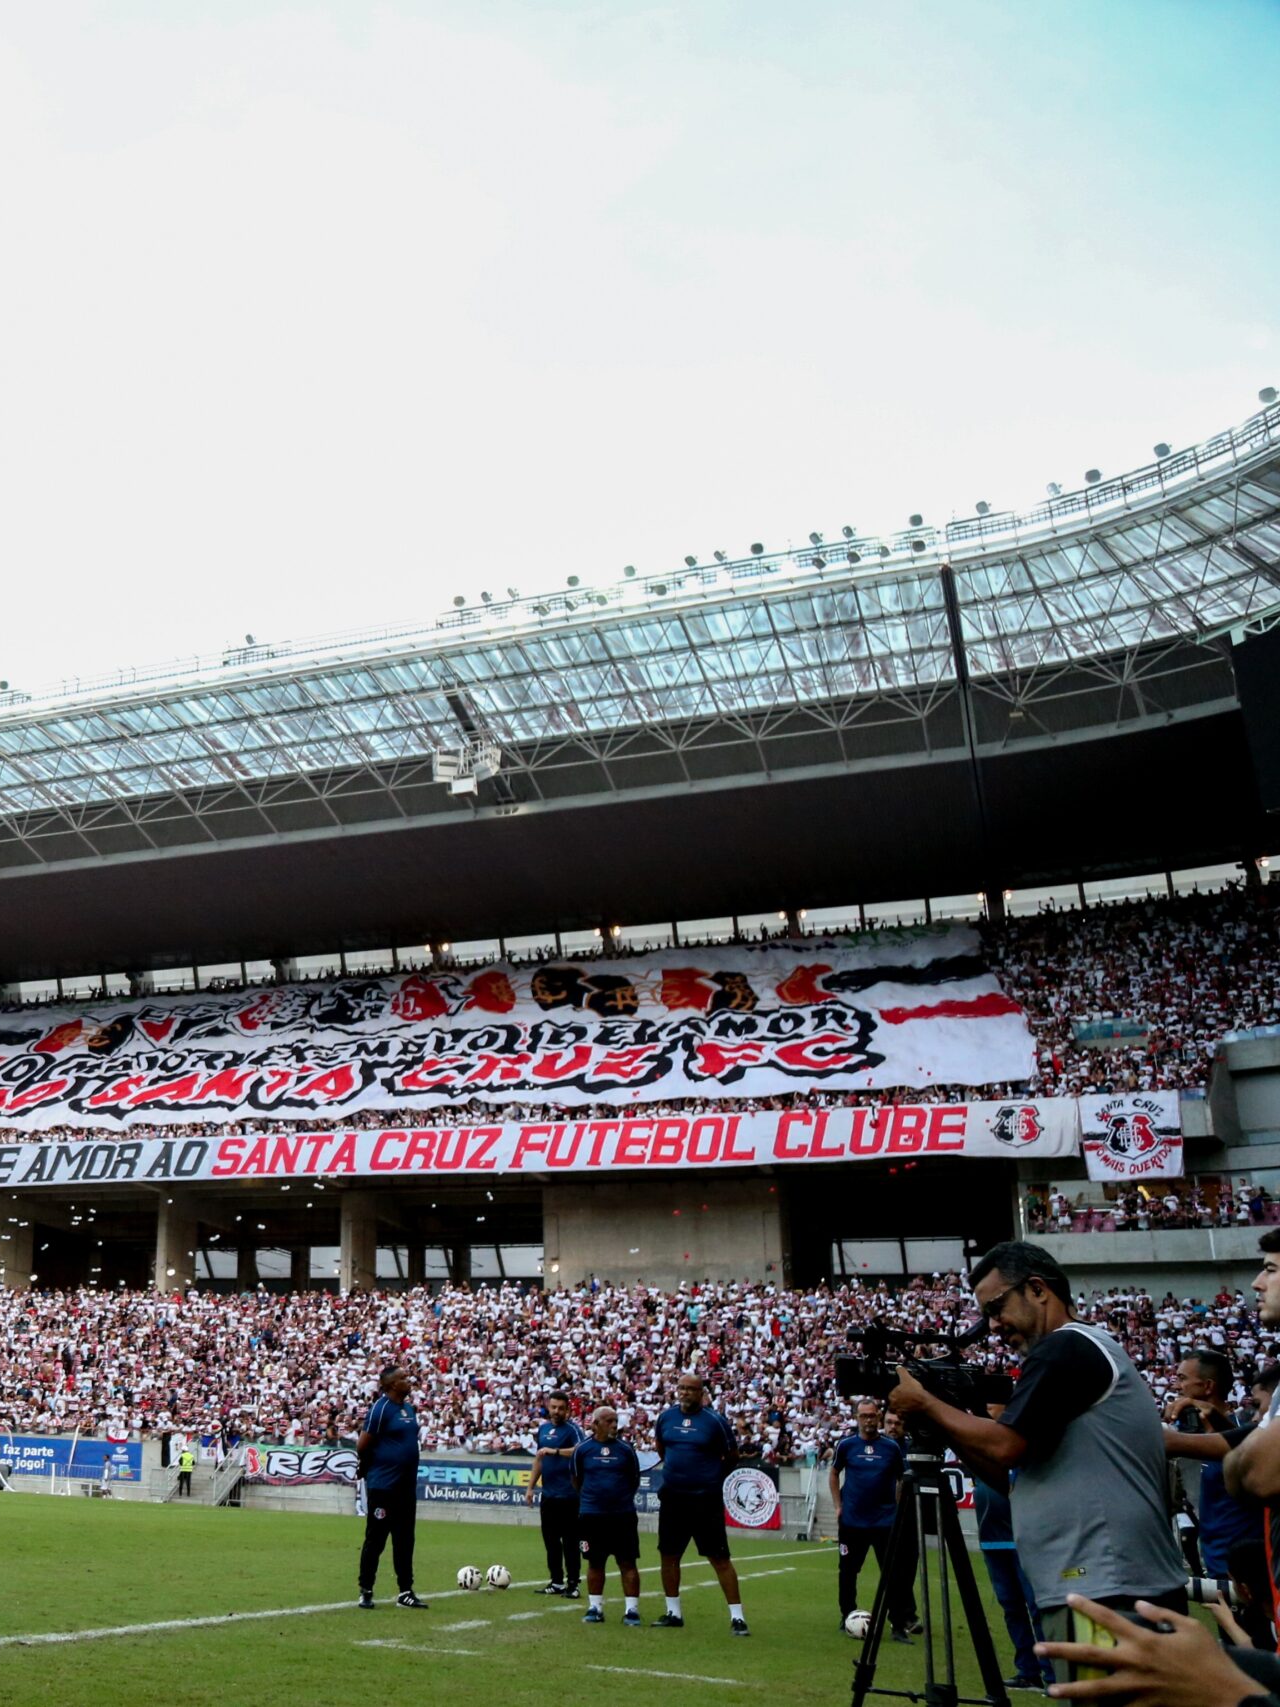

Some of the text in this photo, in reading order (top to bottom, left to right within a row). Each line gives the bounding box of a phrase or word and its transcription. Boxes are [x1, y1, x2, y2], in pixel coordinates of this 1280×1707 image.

[1132, 1098, 1165, 1117] CRUZ
[18, 1143, 143, 1183] AMOR
[145, 1141, 208, 1178] AO
[212, 1135, 357, 1176] SANTA
[369, 1128, 503, 1171] CRUZ
[509, 1117, 755, 1169] FUTEBOL
[773, 1106, 967, 1159] CLUBE
[1100, 1154, 1125, 1173] MAIS
[1129, 1145, 1172, 1175] QUERIDO
[3, 1446, 21, 1456] faz
[24, 1447, 55, 1458] parte
[15, 1458, 45, 1471] jogo!
[425, 1485, 509, 1502] Naturalmente
